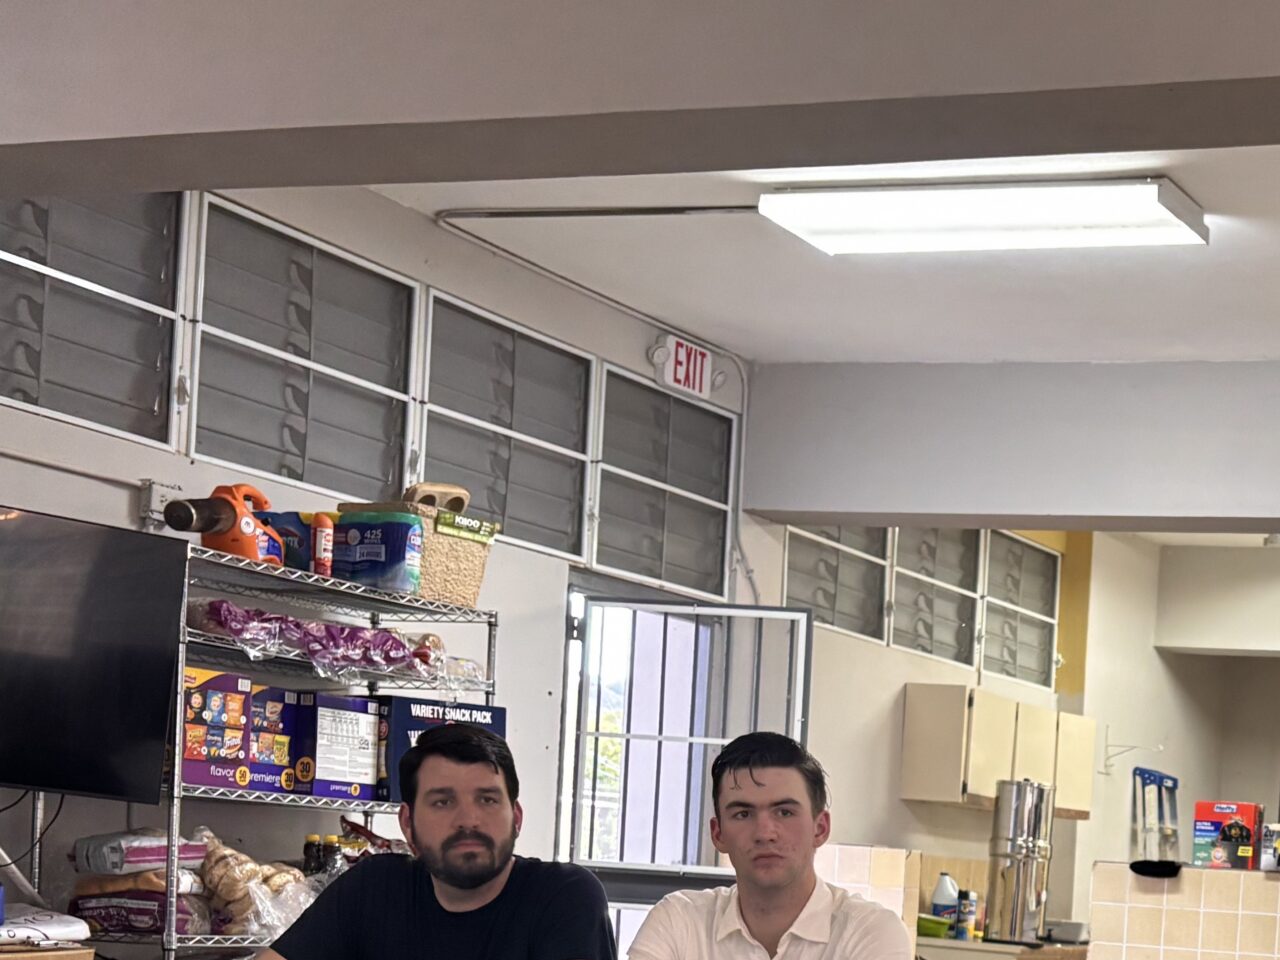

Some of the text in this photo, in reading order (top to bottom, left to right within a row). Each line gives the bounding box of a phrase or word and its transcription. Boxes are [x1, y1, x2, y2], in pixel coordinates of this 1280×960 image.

[674, 340, 707, 393] EXIT
[364, 529, 382, 539] 425
[410, 703, 493, 724] VARIETY SNACK PACK
[210, 765, 235, 777] flavor
[250, 772, 281, 784] remiere
